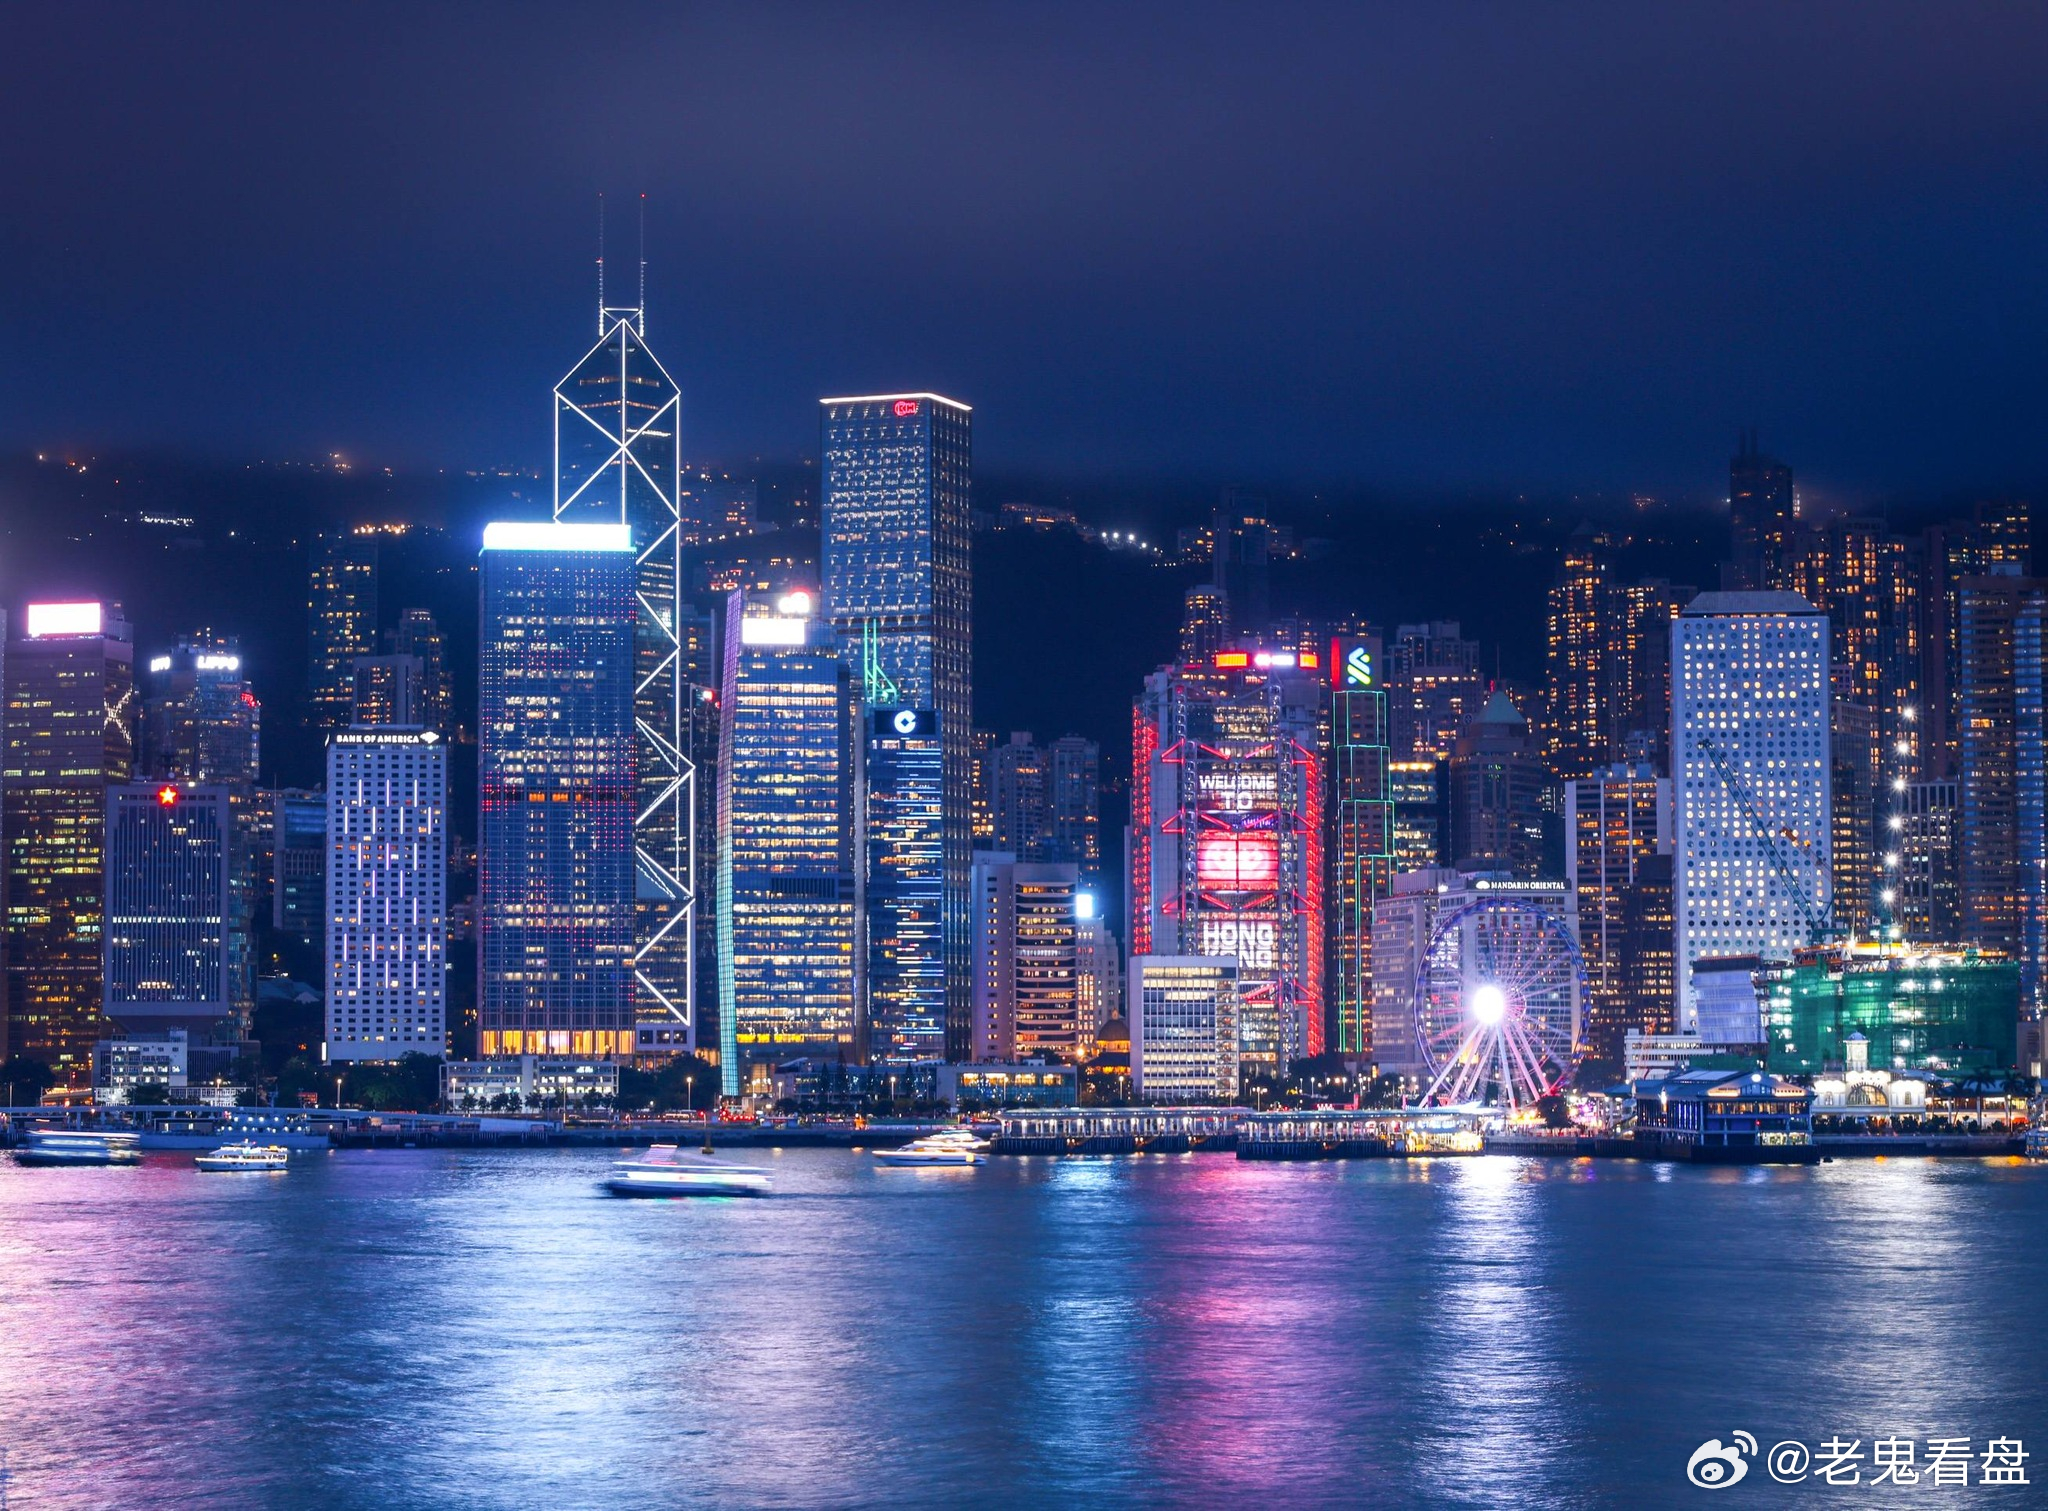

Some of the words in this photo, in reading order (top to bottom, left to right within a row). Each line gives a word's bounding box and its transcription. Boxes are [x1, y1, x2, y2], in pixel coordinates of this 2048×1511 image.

[197, 655, 239, 671] LIPPO
[336, 734, 363, 743] BANK
[363, 734, 376, 743] OF
[377, 735, 420, 744] AMERICA
[1199, 775, 1275, 790] WELCOME
[1220, 791, 1253, 810] TO
[1491, 881, 1530, 890] MANDARIN
[1530, 881, 1565, 890] ORIENTAL
[1203, 921, 1274, 945] HONG
